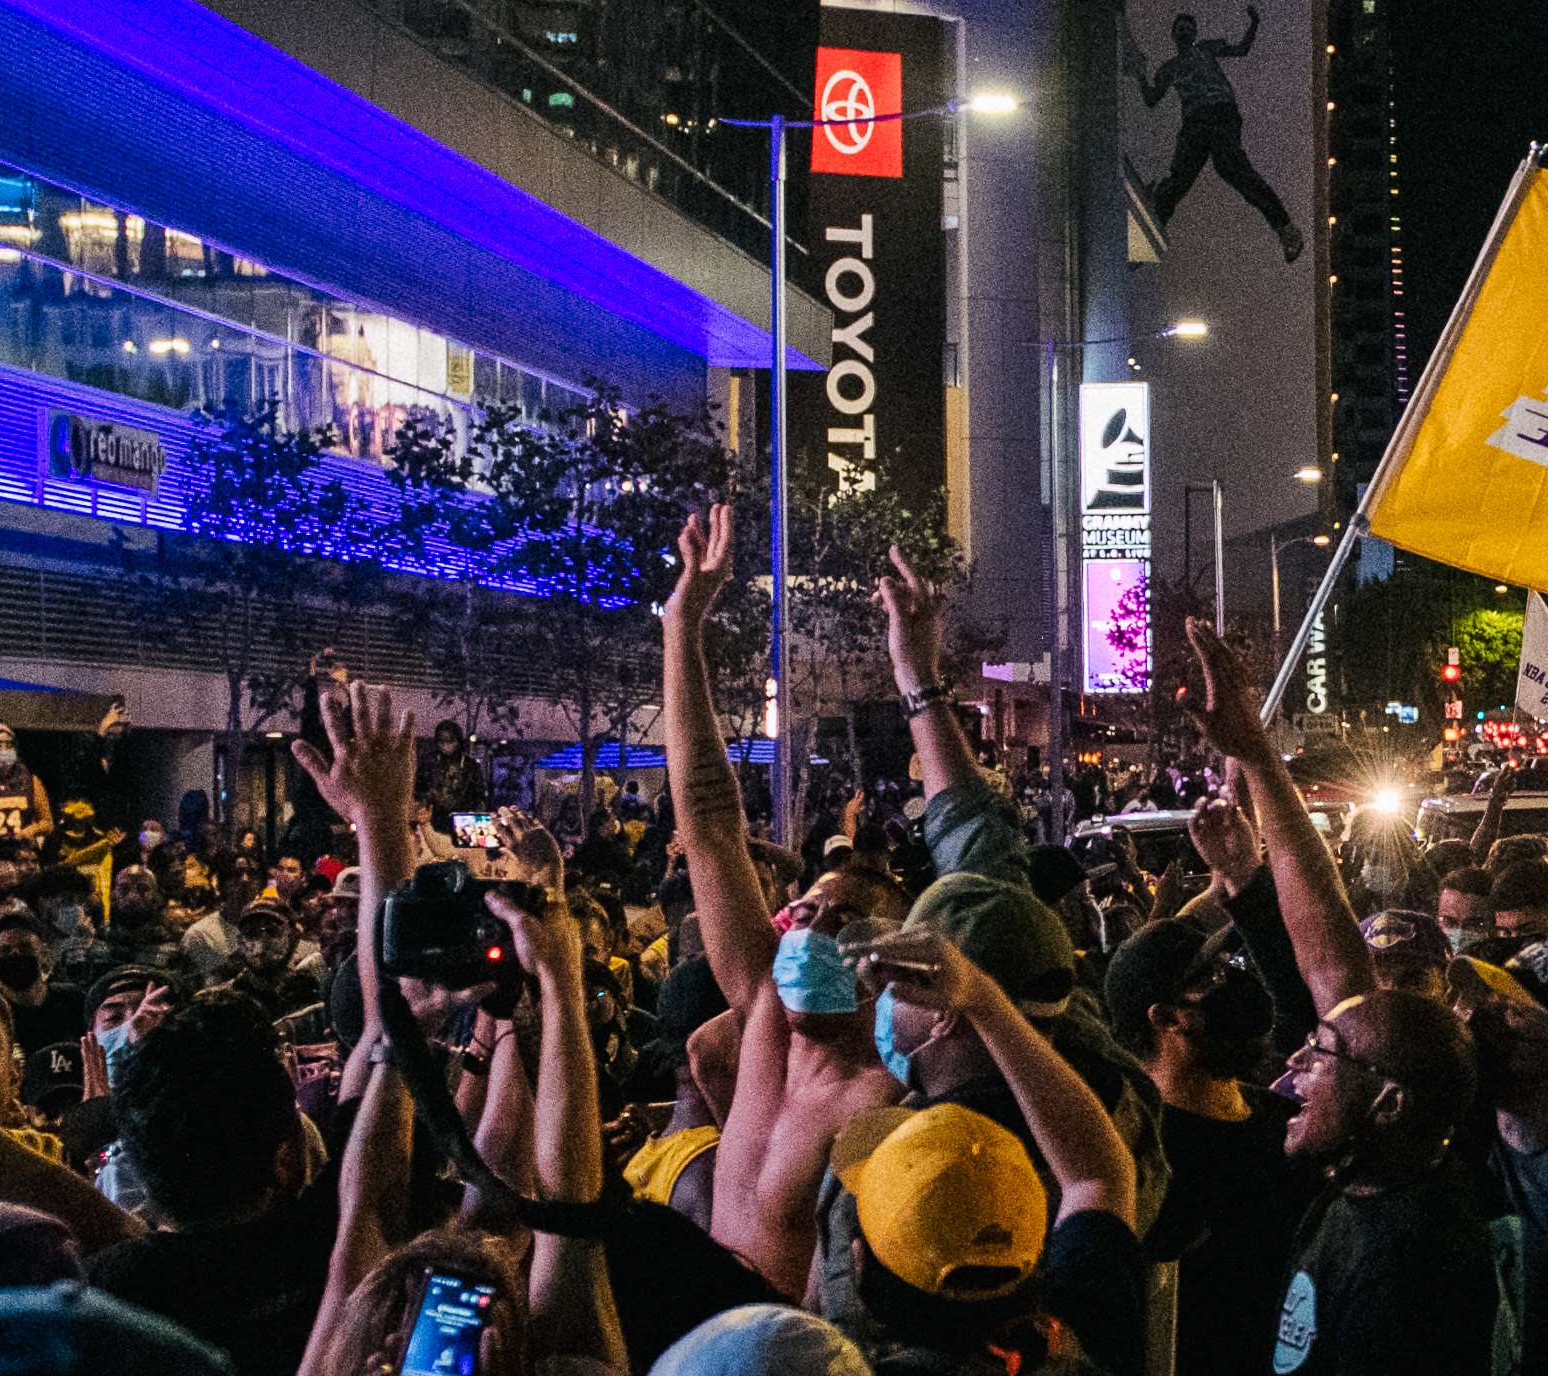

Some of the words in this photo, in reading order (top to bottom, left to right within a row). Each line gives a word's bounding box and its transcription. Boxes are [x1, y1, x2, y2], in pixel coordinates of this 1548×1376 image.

[825, 214, 876, 498] TOYOTA
[1082, 530, 1151, 544] MUSEUM
[1523, 662, 1544, 685] NBA
[1307, 658, 1327, 714] CAR
[49, 1050, 73, 1073] LA
